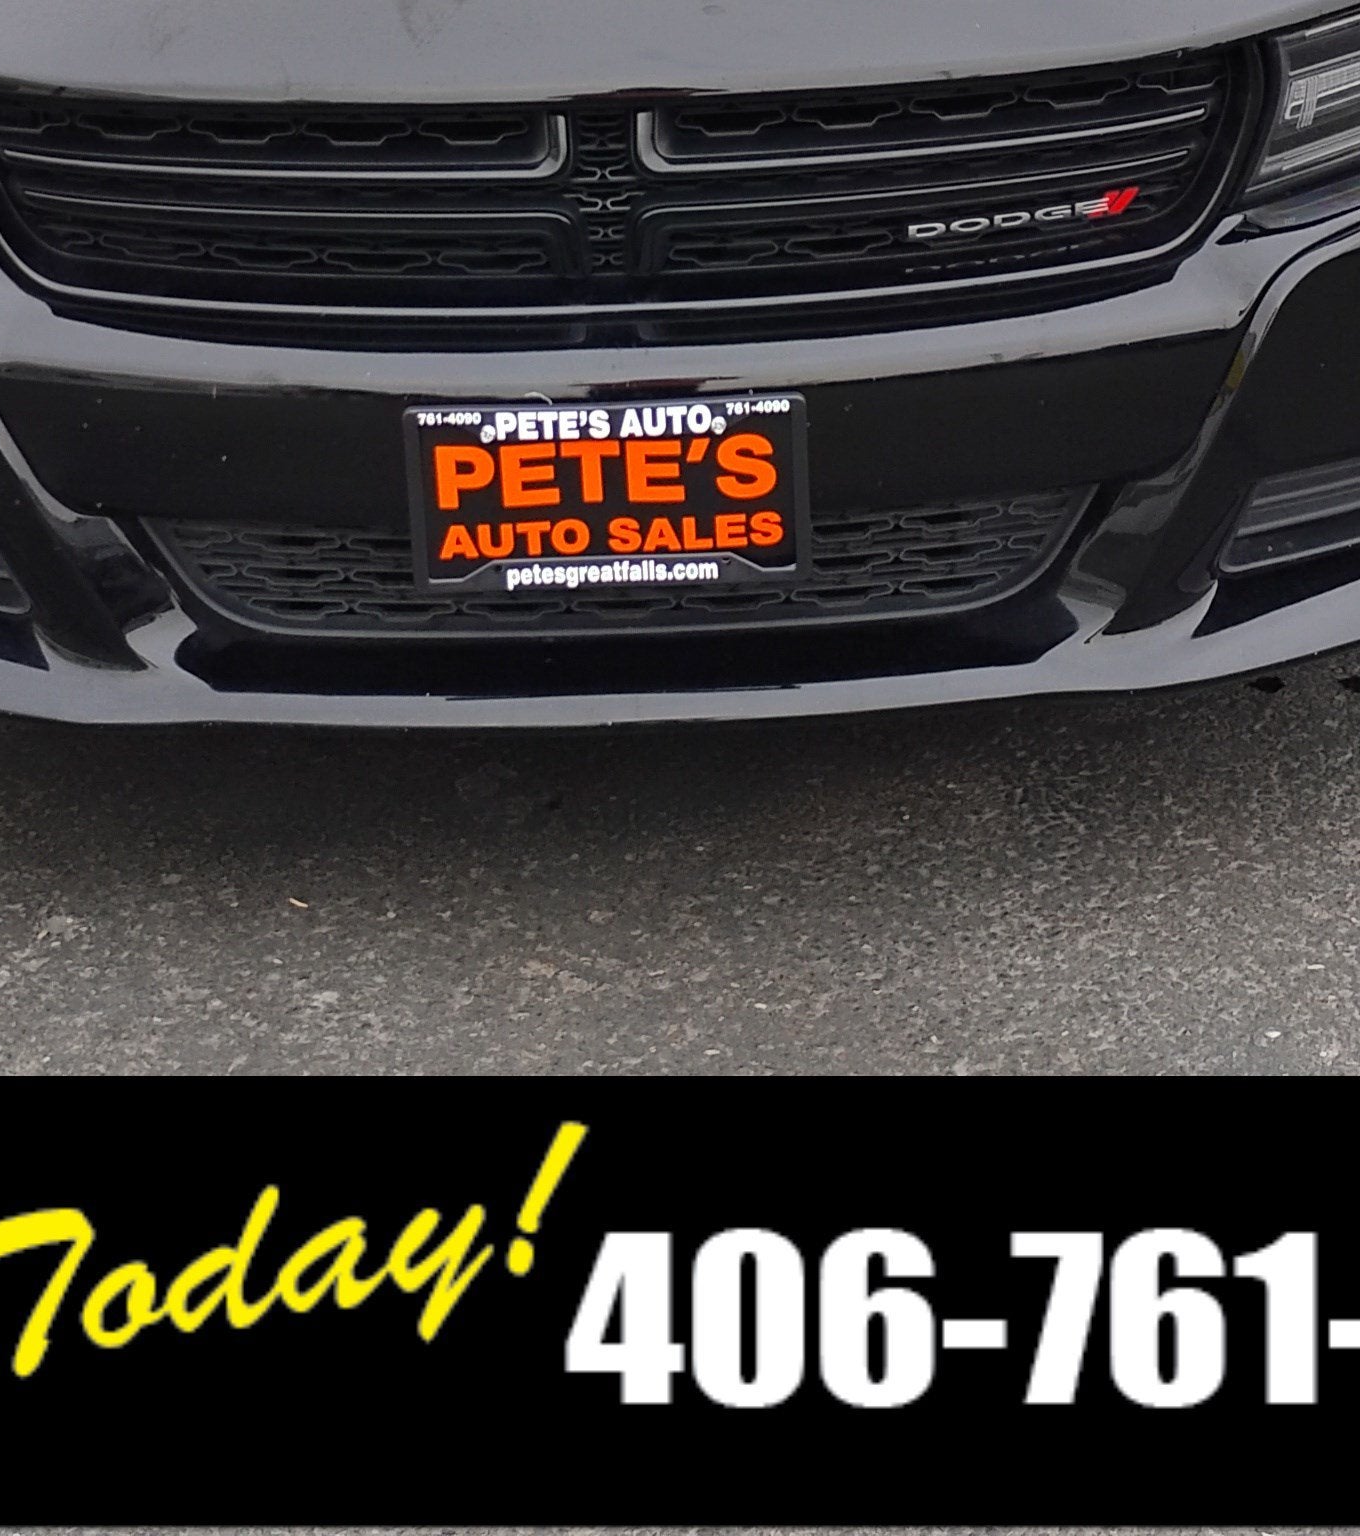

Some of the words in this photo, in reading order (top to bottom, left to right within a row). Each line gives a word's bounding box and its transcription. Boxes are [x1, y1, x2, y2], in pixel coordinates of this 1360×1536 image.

[908, 197, 1110, 241] DODGE
[417, 412, 482, 427] 761-4090
[495, 409, 610, 441] PETE'S
[619, 404, 712, 438] AUTO
[725, 399, 791, 416] 761-4090
[435, 433, 778, 510] PETE'S
[440, 519, 590, 560] AUTO
[608, 511, 784, 553] SALES
[506, 560, 719, 591] petesgreatfalls.com
